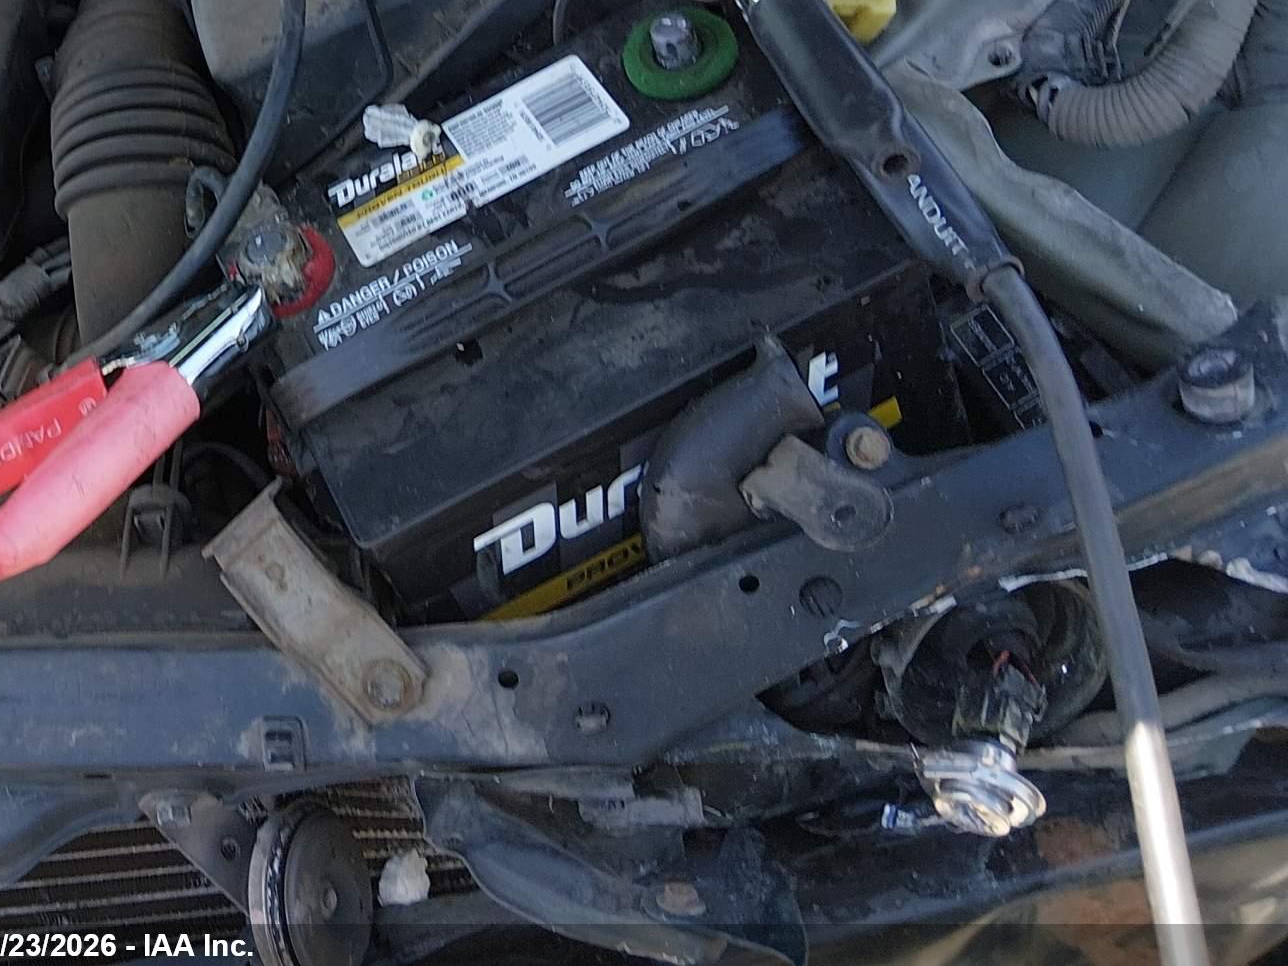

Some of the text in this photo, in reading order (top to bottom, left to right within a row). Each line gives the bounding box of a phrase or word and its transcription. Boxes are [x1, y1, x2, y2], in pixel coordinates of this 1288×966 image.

[327, 136, 446, 208] Durala
[329, 275, 391, 316] DANGER
[403, 238, 460, 277] POISON
